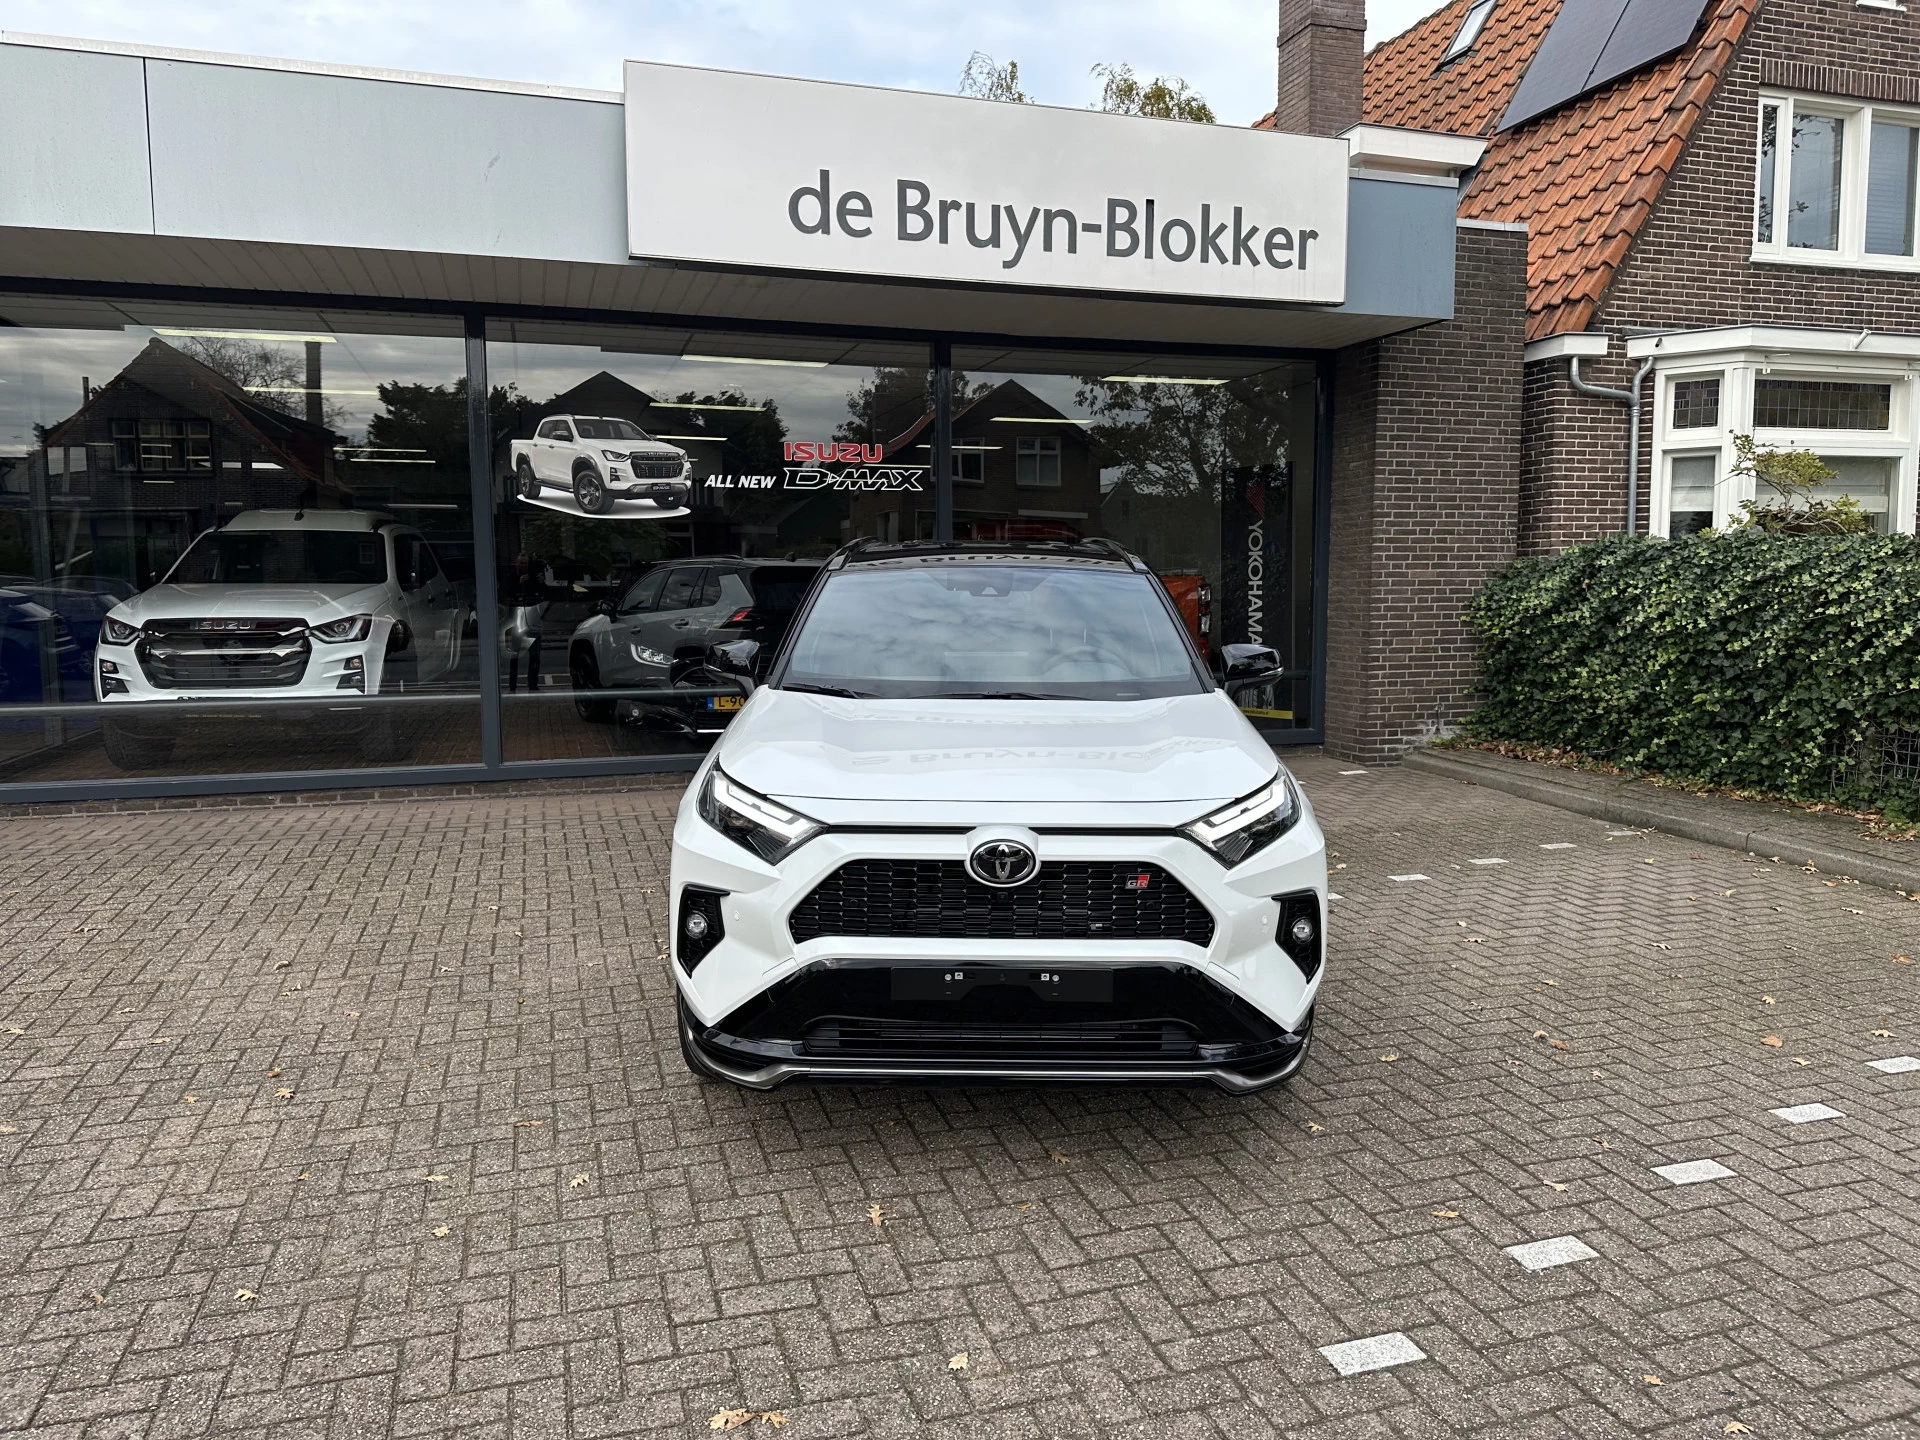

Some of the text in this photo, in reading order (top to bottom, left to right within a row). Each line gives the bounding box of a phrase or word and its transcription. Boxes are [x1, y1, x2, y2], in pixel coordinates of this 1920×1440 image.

[788, 169, 1320, 270] de Bruyn-Blokker
[783, 441, 883, 463] ISUZU
[704, 467, 924, 491] ALL NEW D-MAX
[1248, 519, 1263, 645] YOKOHAMA
[195, 621, 250, 630] ISUZU
